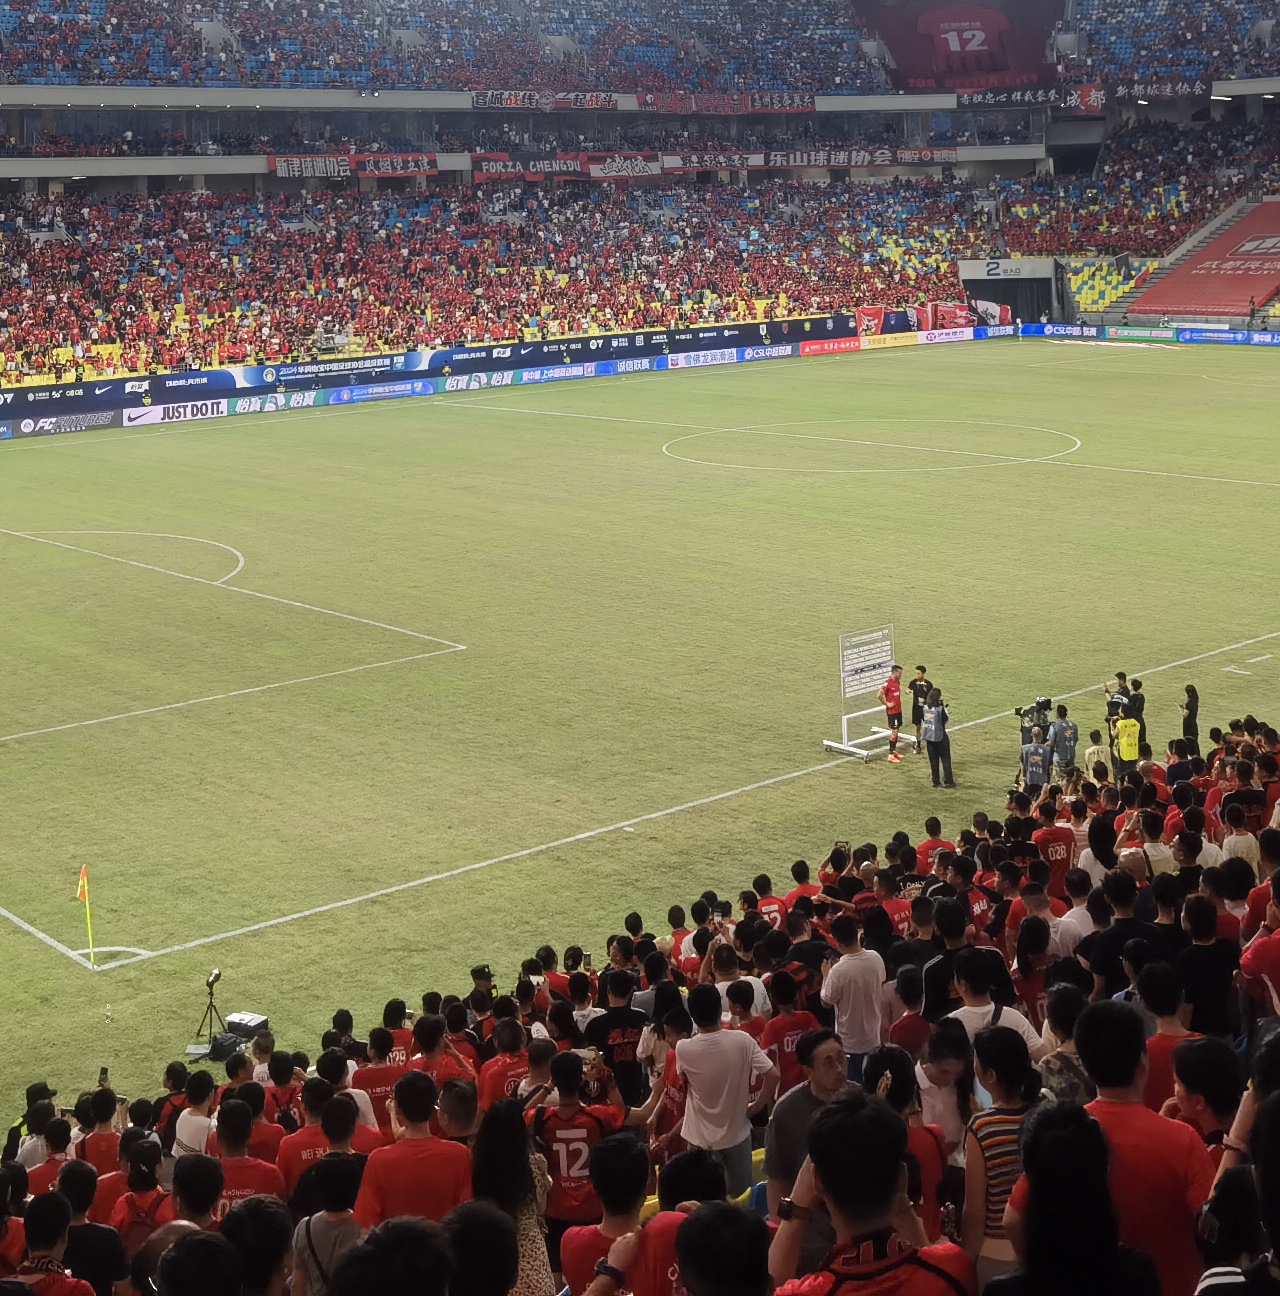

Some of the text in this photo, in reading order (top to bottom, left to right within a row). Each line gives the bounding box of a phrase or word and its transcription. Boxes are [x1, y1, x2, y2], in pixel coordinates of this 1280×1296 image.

[940, 30, 989, 52] 12
[481, 159, 582, 174] FORZA CHENGDU
[768, 150, 893, 167] 乐山球迷协会
[985, 261, 1001, 277] 2
[160, 401, 224, 421] JUST DO IT.
[35, 418, 57, 432] FC
[1048, 844, 1067, 861] 028
[552, 1141, 590, 1178] 12
